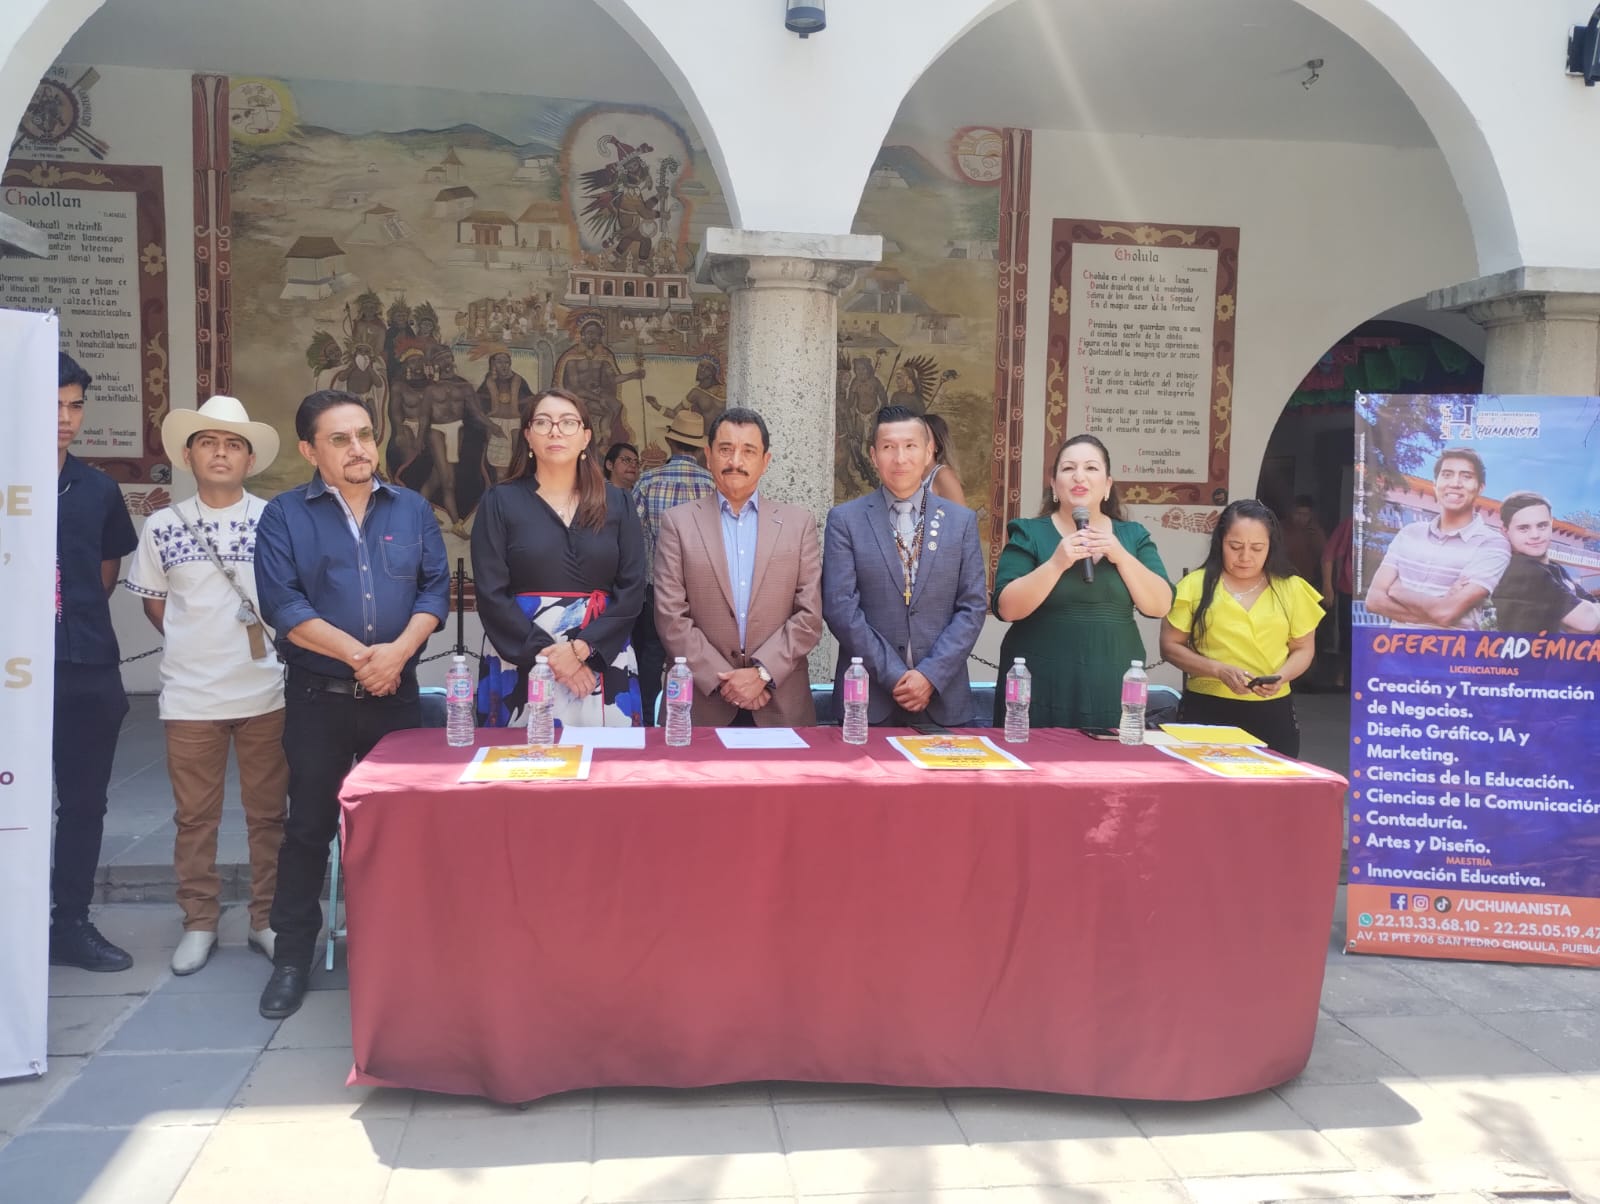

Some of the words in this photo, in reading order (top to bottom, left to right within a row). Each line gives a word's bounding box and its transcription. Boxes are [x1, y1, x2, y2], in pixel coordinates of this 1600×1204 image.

[5, 189, 81, 208] Cholollan
[1115, 248, 1159, 262] Cholula
[1478, 426, 1538, 438] HUMANISTA
[0, 485, 32, 516] E
[1373, 634, 1466, 658] OFERTA
[1475, 631, 1600, 662] ACADÉMICA
[1450, 666, 1519, 676] LICENCIATURAS
[1368, 678, 1442, 695] Creación
[1446, 685, 1457, 699] y
[1461, 682, 1595, 701] Transformación
[1368, 700, 1387, 714] de
[1392, 701, 1473, 720] Negocios.
[1368, 722, 1422, 738] Diseño
[1427, 724, 1494, 744] Gráfico,
[1499, 728, 1516, 743] IA
[1520, 732, 1530, 746] y
[1368, 744, 1459, 765] Marketing.
[1367, 766, 1436, 784] Ciencias
[1440, 770, 1460, 785] de
[1465, 771, 1481, 786] la
[1485, 772, 1574, 790] Educación.
[1367, 789, 1435, 806] Ciencias
[1440, 792, 1460, 807] de
[1465, 793, 1481, 808] la
[1367, 811, 1467, 830] Contaduría.
[1366, 833, 1410, 850] Artes
[1415, 838, 1425, 854] y
[1430, 836, 1490, 854] Diseño.
[1447, 855, 1492, 866] MAESTRÍA
[1368, 864, 1456, 882] Innovación
[1461, 869, 1546, 887] Educativa.
[1457, 897, 1572, 917] /UCHUMANISTA
[1376, 914, 1480, 932] 22.13.33.68.10
[1494, 922, 1600, 940] 22.25.05.19.47
[1357, 931, 1376, 941] AV.
[1379, 933, 1389, 942] 12
[1392, 934, 1410, 943] PTE
[1414, 935, 1434, 944] 706
[1438, 936, 1461, 946] SAN
[1464, 938, 1500, 949] PEDRO
[1503, 940, 1559, 953] CHOLULA,
[1562, 943, 1600, 955] PUEBLA
